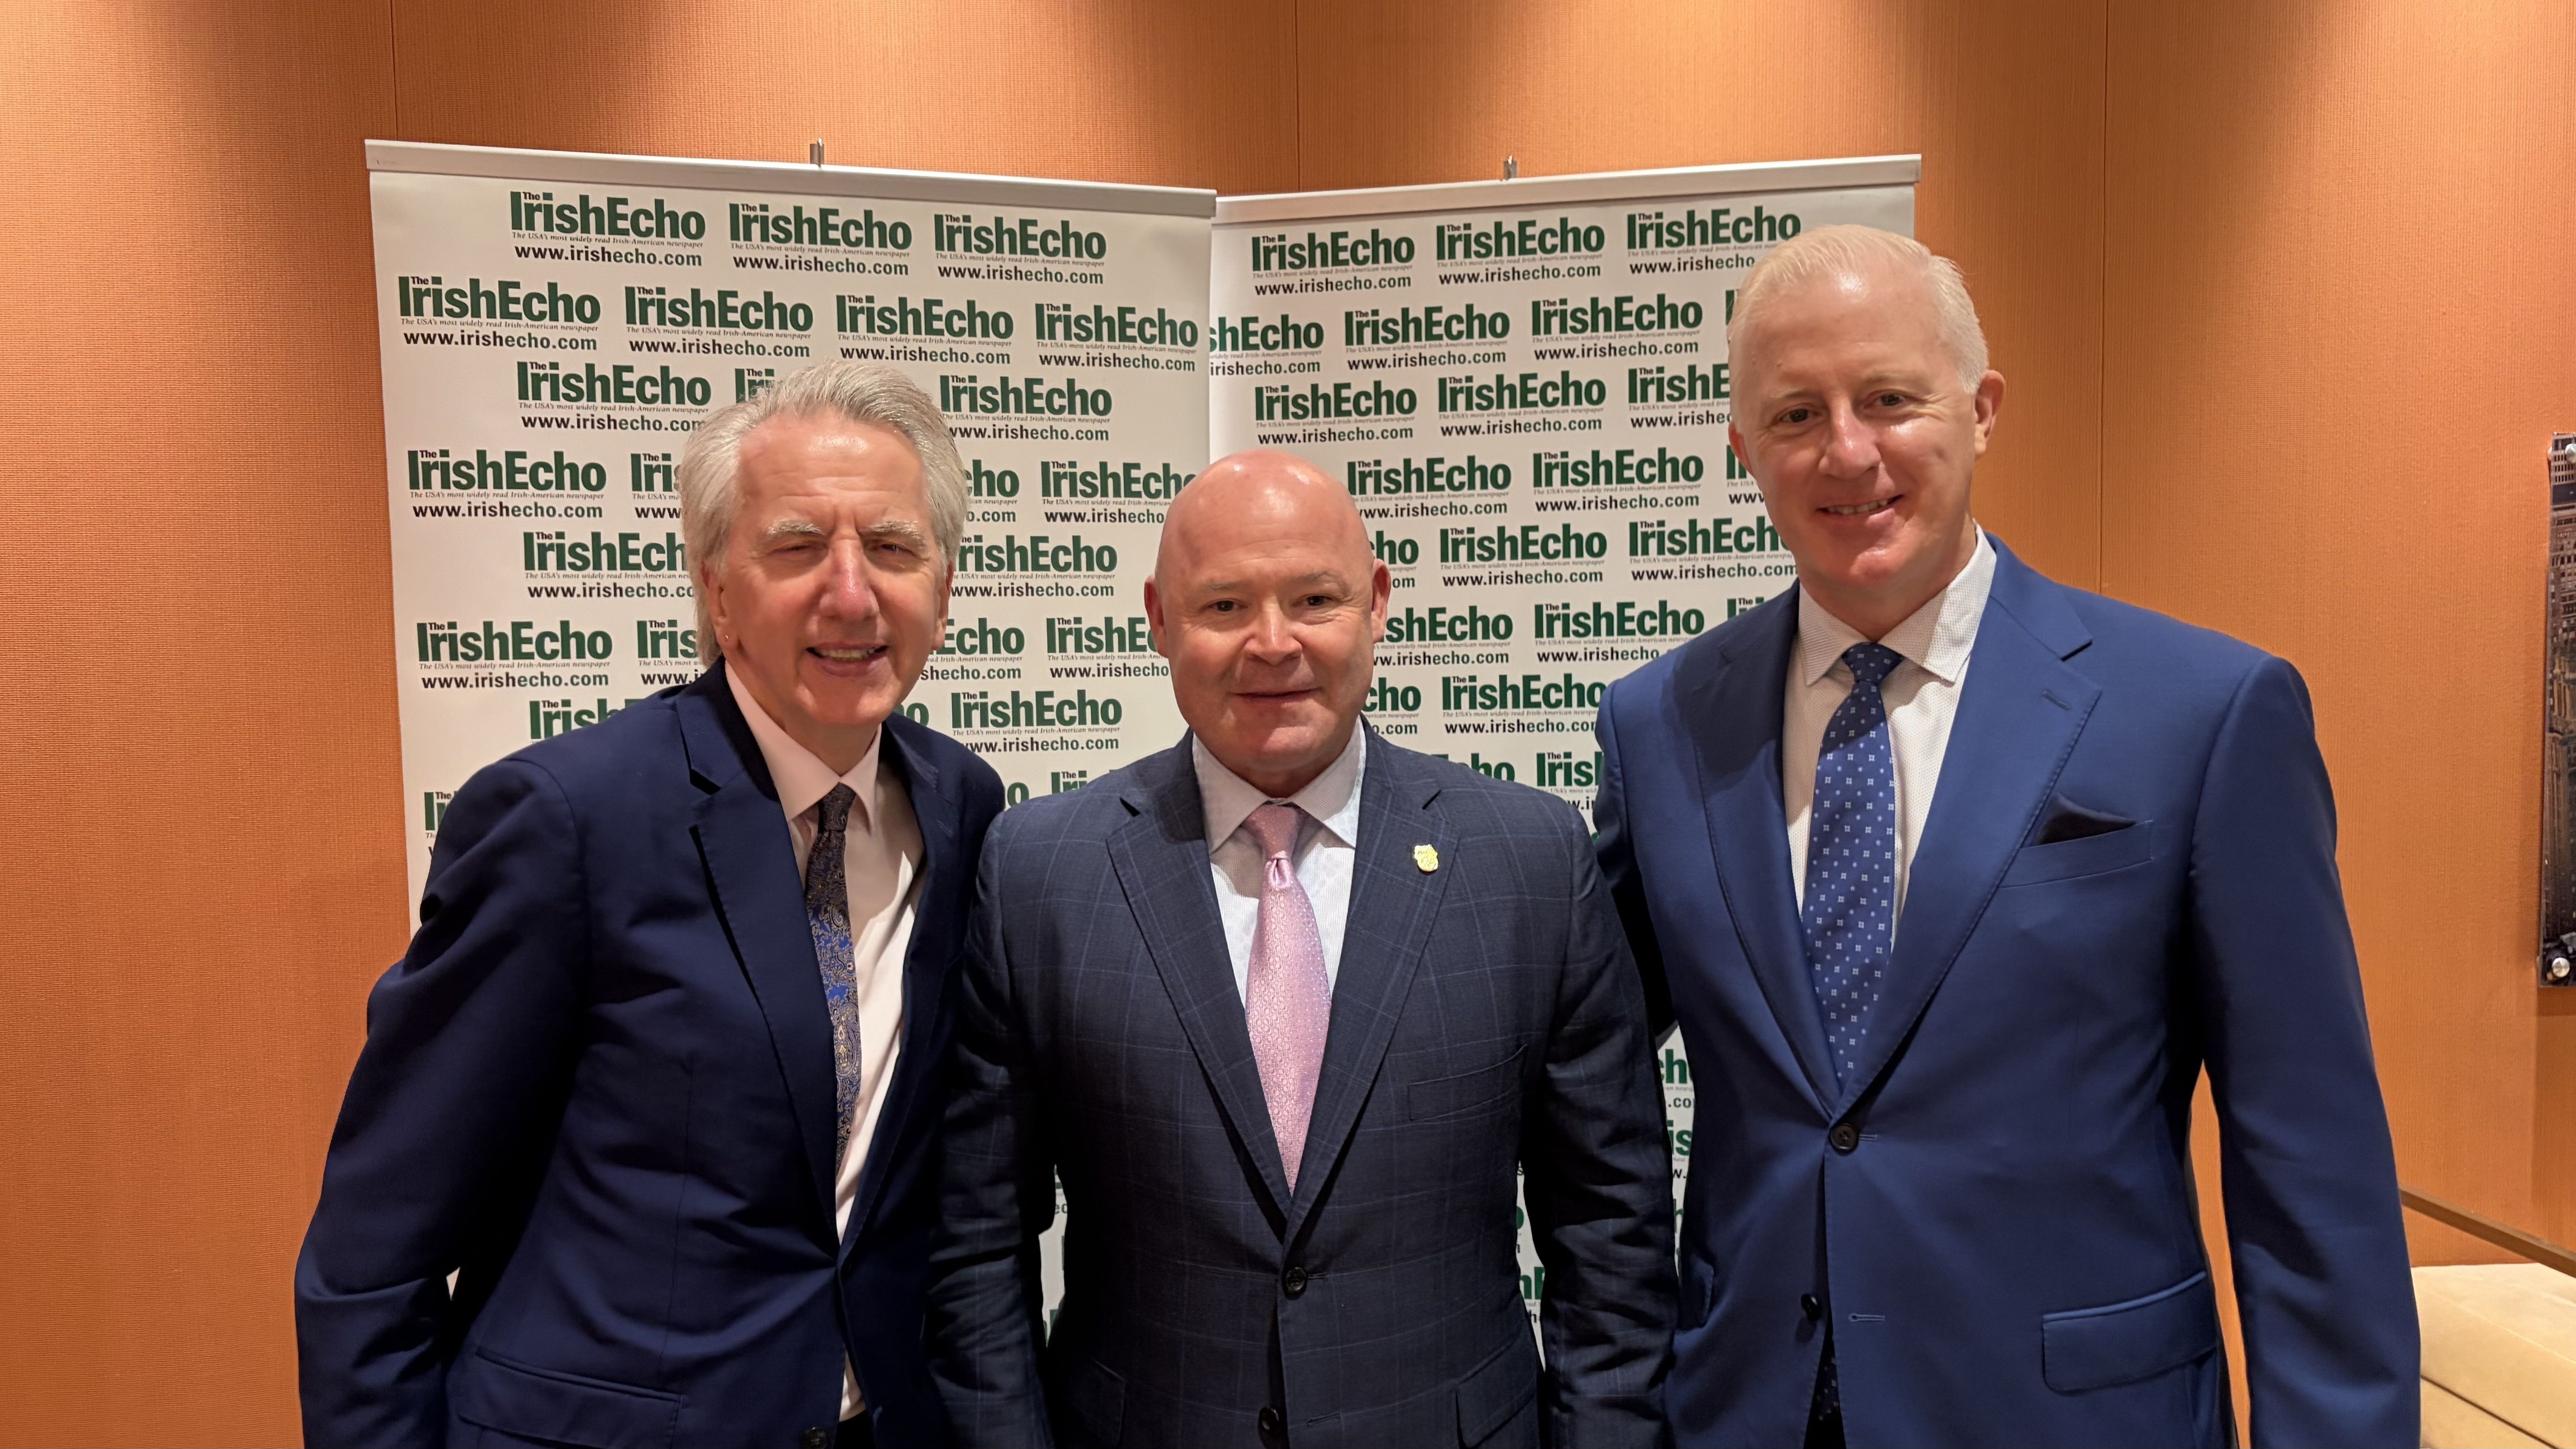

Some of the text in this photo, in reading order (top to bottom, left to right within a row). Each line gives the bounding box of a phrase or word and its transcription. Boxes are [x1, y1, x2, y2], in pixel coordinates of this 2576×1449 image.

[510, 191, 706, 240] The IrishEcho
[729, 203, 912, 250] The IrishEcho
[1627, 206, 1801, 250] The IrishEcho
[528, 231, 547, 239] USA's
[567, 234, 591, 243] widely
[612, 236, 664, 245] Irish-American
[667, 239, 704, 249] newspaper
[934, 214, 1106, 259] The IrishEcho
[1436, 217, 1605, 261] The IrishEcho
[514, 244, 702, 266] www.irishecho.com
[1251, 229, 1415, 271] IrishEcho
[733, 256, 908, 276] www.irishecho.com
[984, 254, 1006, 263] widely
[1024, 256, 1070, 265] Irish-American
[1072, 259, 1104, 268] newspaper
[1629, 254, 1755, 275] www.irishecho
[938, 266, 1103, 284] www.irishecho.com
[1439, 265, 1601, 285] www.irishecho.com
[1255, 276, 1411, 295] www.irishecho.com
[398, 276, 601, 324] The IrishEcho
[625, 286, 813, 331] The IrishEcho
[836, 294, 1014, 339] The IrishEcho
[1532, 293, 1703, 336] IrishEcho
[1035, 303, 1198, 347] The IrishEcho
[1344, 304, 1510, 346] IrishEcho
[403, 331, 597, 350] www.irishecho.com
[629, 339, 810, 357] www.irishecho.com
[840, 346, 1010, 364] www.irishecho.com
[1348, 350, 1506, 370] www.irishecho.com
[1535, 341, 1698, 360] www.irishecho.com
[529, 361, 547, 370] The
[1039, 353, 1195, 372] www.irishecho.com
[1210, 360, 1320, 376] irishecho.com
[746, 368, 763, 377] The
[517, 361, 711, 406] IrishEcho
[1438, 370, 1606, 413] IrishEcho
[1628, 363, 1731, 404] The IrishE
[940, 375, 1112, 416] The IrishEcho
[1255, 380, 1417, 421] The IrishEcho
[521, 414, 705, 432] www.irishecho.com
[1441, 418, 1601, 437] www.irishecho.com
[1631, 411, 1731, 429] www.irishec
[1258, 427, 1413, 444] www.irishecho.com
[419, 450, 437, 458] The
[642, 453, 659, 462] The
[1543, 452, 1558, 460] The
[407, 449, 607, 492] IrishEcho
[1051, 461, 1067, 469] The
[1533, 447, 1704, 488] IrishEcho
[1040, 460, 1197, 499] IrishEch
[1347, 455, 1511, 496] IrishEcho
[466, 491, 490, 500] widely
[567, 493, 604, 501] newspaper
[1536, 494, 1699, 512] www.irishecho.com
[412, 501, 603, 518] www.irishecho.com
[1044, 508, 1164, 524] www.irishecho
[1450, 528, 1465, 536] The
[1628, 515, 1787, 557] IrishEch
[523, 531, 687, 572] The IrishEch
[1440, 523, 1607, 563] IrishEcho
[958, 535, 1118, 573] he rishEcho
[1442, 570, 1603, 587] www.irishecho.com
[528, 582, 694, 599] www.irishecho.co
[1545, 603, 1559, 611] The
[1738, 597, 1753, 606] The
[428, 622, 445, 630] The
[648, 620, 666, 628] The
[1380, 605, 1513, 642] shEcho
[1534, 600, 1705, 639] IrishEcho
[416, 620, 612, 662] IrishEcho
[1046, 616, 1156, 654] IrishE
[1536, 646, 1660, 663] www.irishecho
[474, 661, 498, 669] widely
[573, 661, 610, 669] newspaper
[920, 665, 1021, 681] shecho.com
[1050, 662, 1169, 678] www.irishecho
[421, 671, 608, 689] www.irishecho.com
[961, 692, 977, 700] The
[1442, 672, 1606, 711] IrishEcho
[541, 700, 559, 708] The
[951, 689, 1122, 729] IrishEcho
[1547, 752, 1561, 760] The
[435, 791, 451, 800] The
